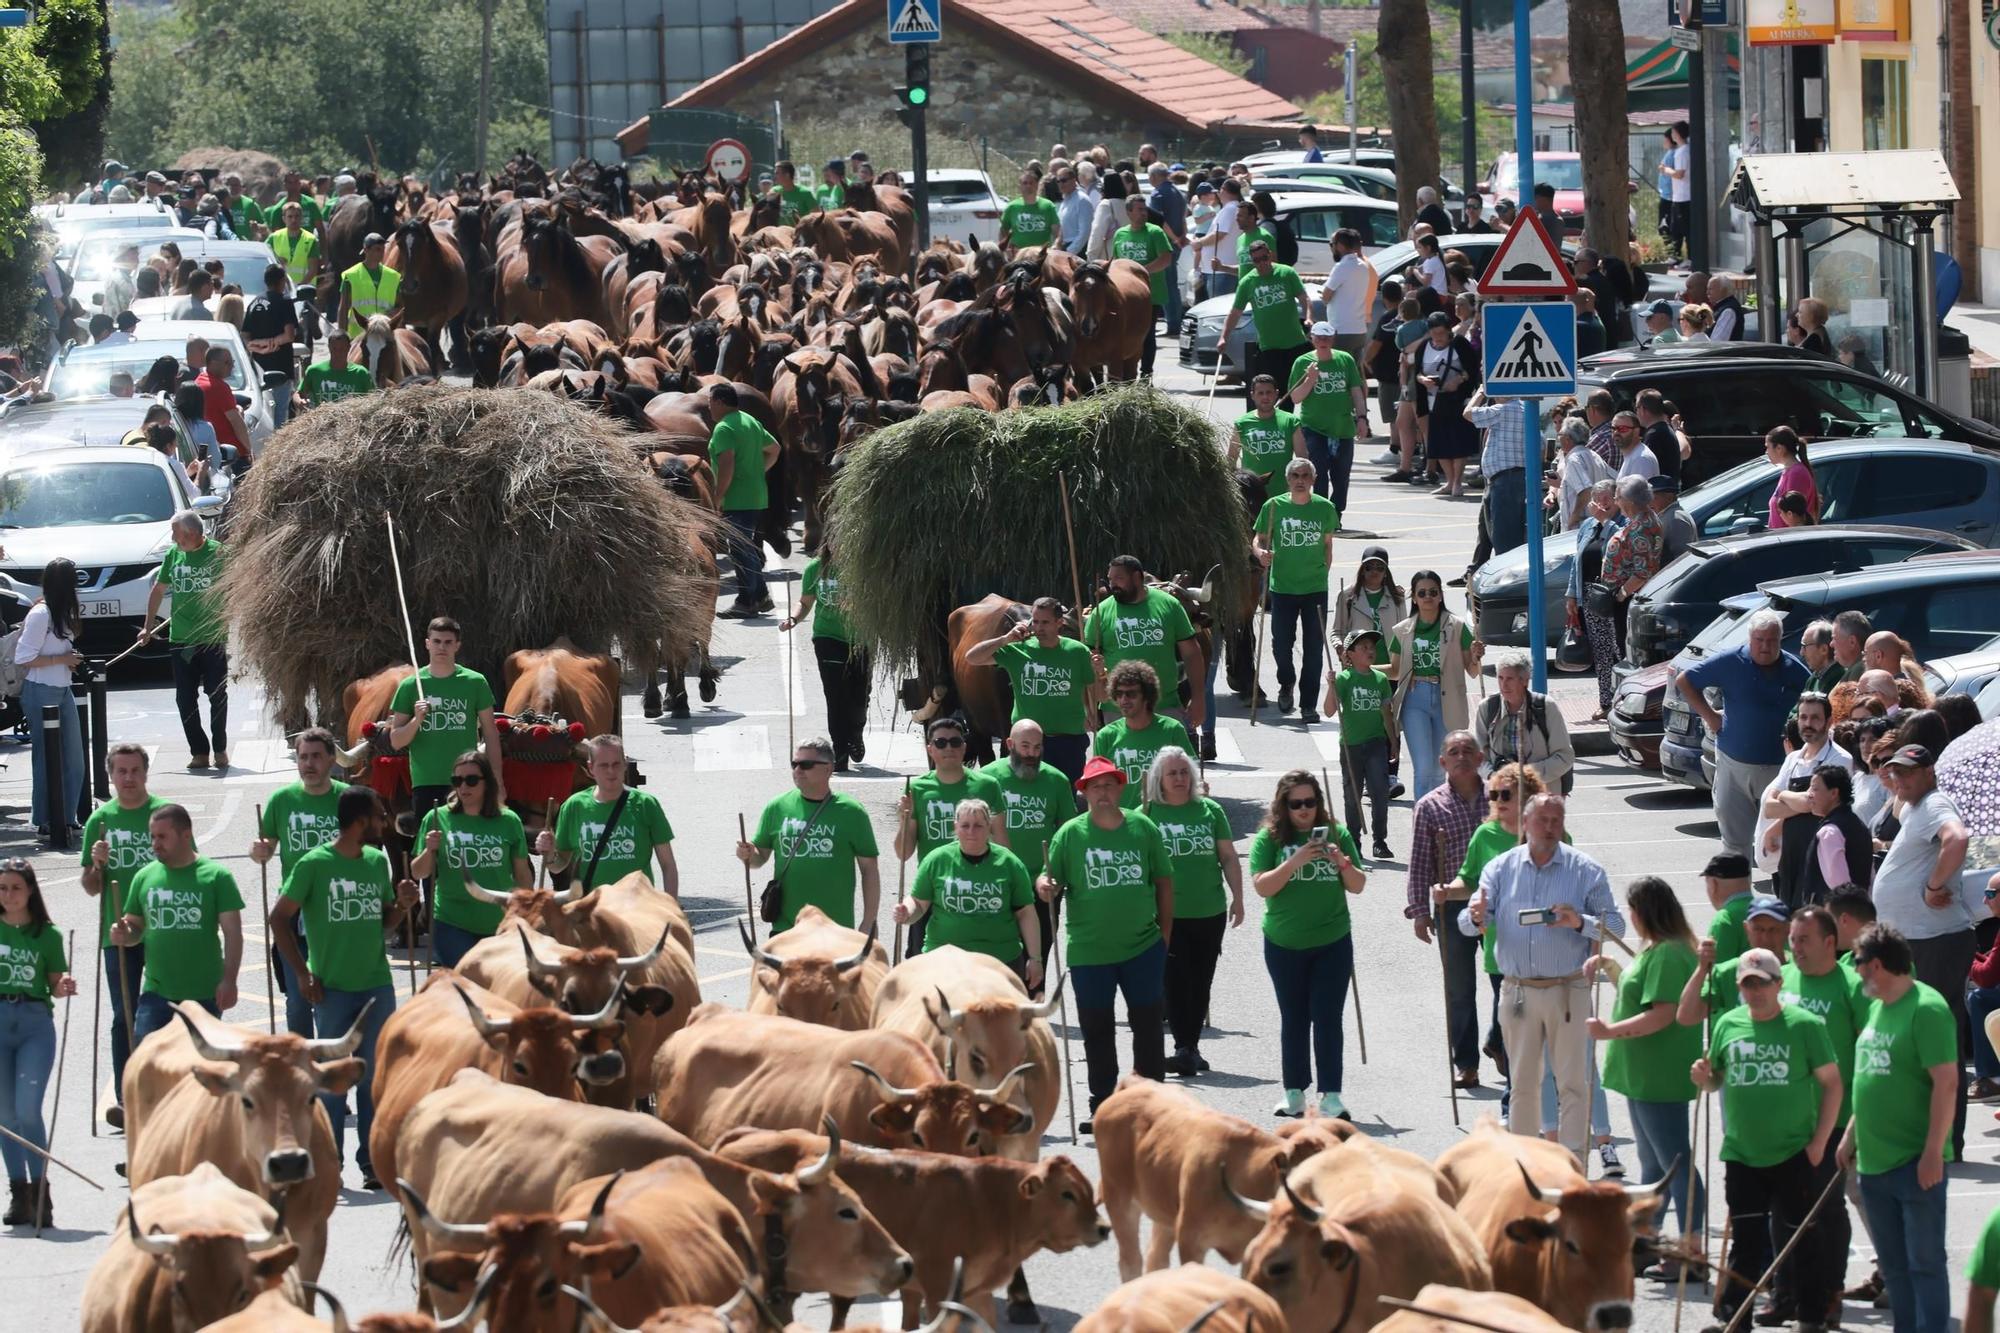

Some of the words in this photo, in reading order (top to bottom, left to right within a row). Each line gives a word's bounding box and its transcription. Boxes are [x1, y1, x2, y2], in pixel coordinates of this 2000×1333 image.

[1266, 431, 1285, 439] SAN
[1301, 521, 1321, 531] SAN
[1280, 529, 1321, 547] ISIDRO
[192, 566, 210, 577] SAN
[92, 603, 116, 616] JBL
[1138, 618, 1162, 629] SAN
[1115, 629, 1165, 649] ISIDRO
[1047, 667, 1071, 679] SAN
[1021, 674, 1070, 696] ISIDRO
[445, 699, 468, 710] SAN
[1021, 795, 1047, 809] SAN
[1006, 809, 1046, 829] IDRO
[808, 825, 836, 837] SAN
[1185, 823, 1213, 837] SAN
[474, 833, 502, 846] SAN
[779, 832, 834, 858] ISIDRO
[446, 845, 503, 868] ISIDRO
[1114, 850, 1142, 864] SAN
[1085, 864, 1143, 889] ISIDRO
[358, 883, 381, 897] SAN
[974, 882, 1002, 895] SAN
[174, 891, 202, 905] SAN
[941, 889, 1003, 914] ISIDRO
[328, 896, 382, 922] ISIDRO
[11, 948, 40, 964] SAN
[1800, 997, 1831, 1014] SAN
[1757, 1044, 1790, 1060] SAN
